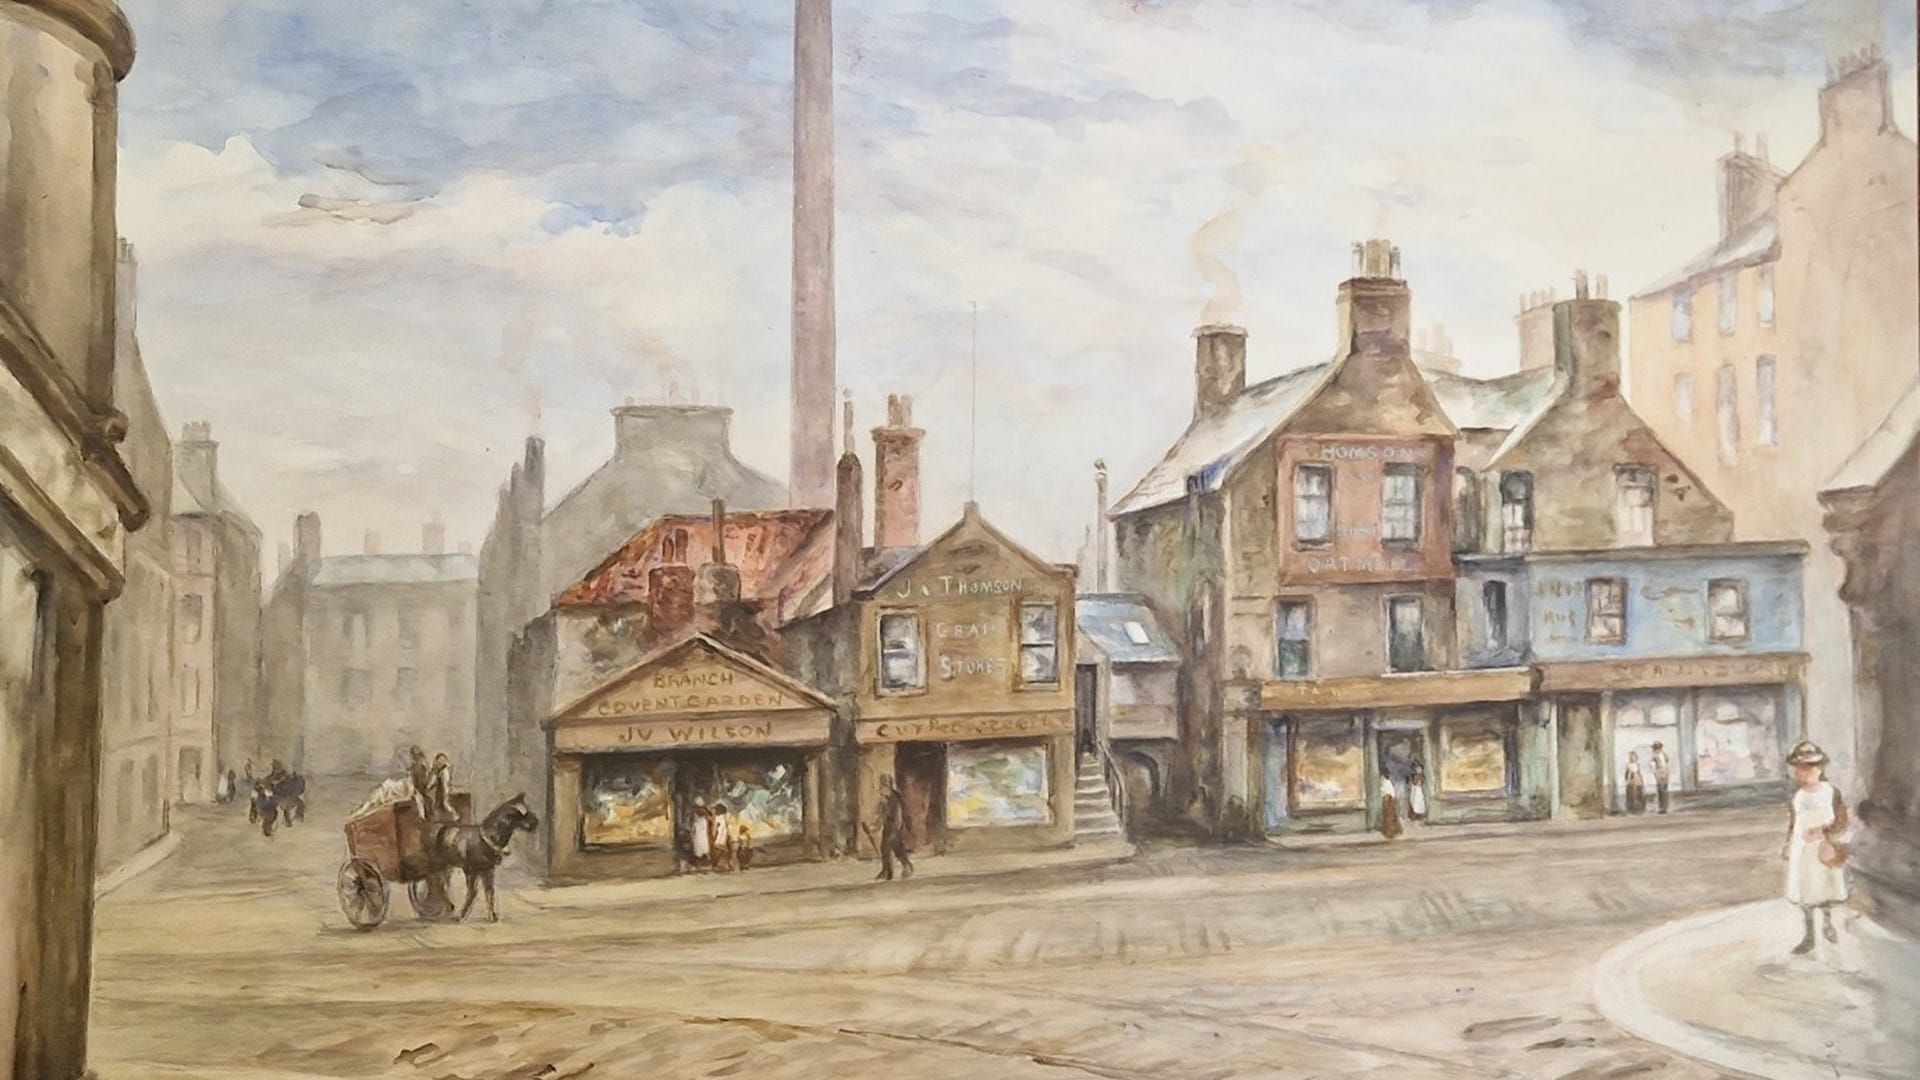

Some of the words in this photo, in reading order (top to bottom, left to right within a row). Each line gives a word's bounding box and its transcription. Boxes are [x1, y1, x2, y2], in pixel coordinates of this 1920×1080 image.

[938, 575, 1023, 595] THOMSON
[653, 672, 734, 688] BRANCH
[668, 721, 772, 742] WILSON
